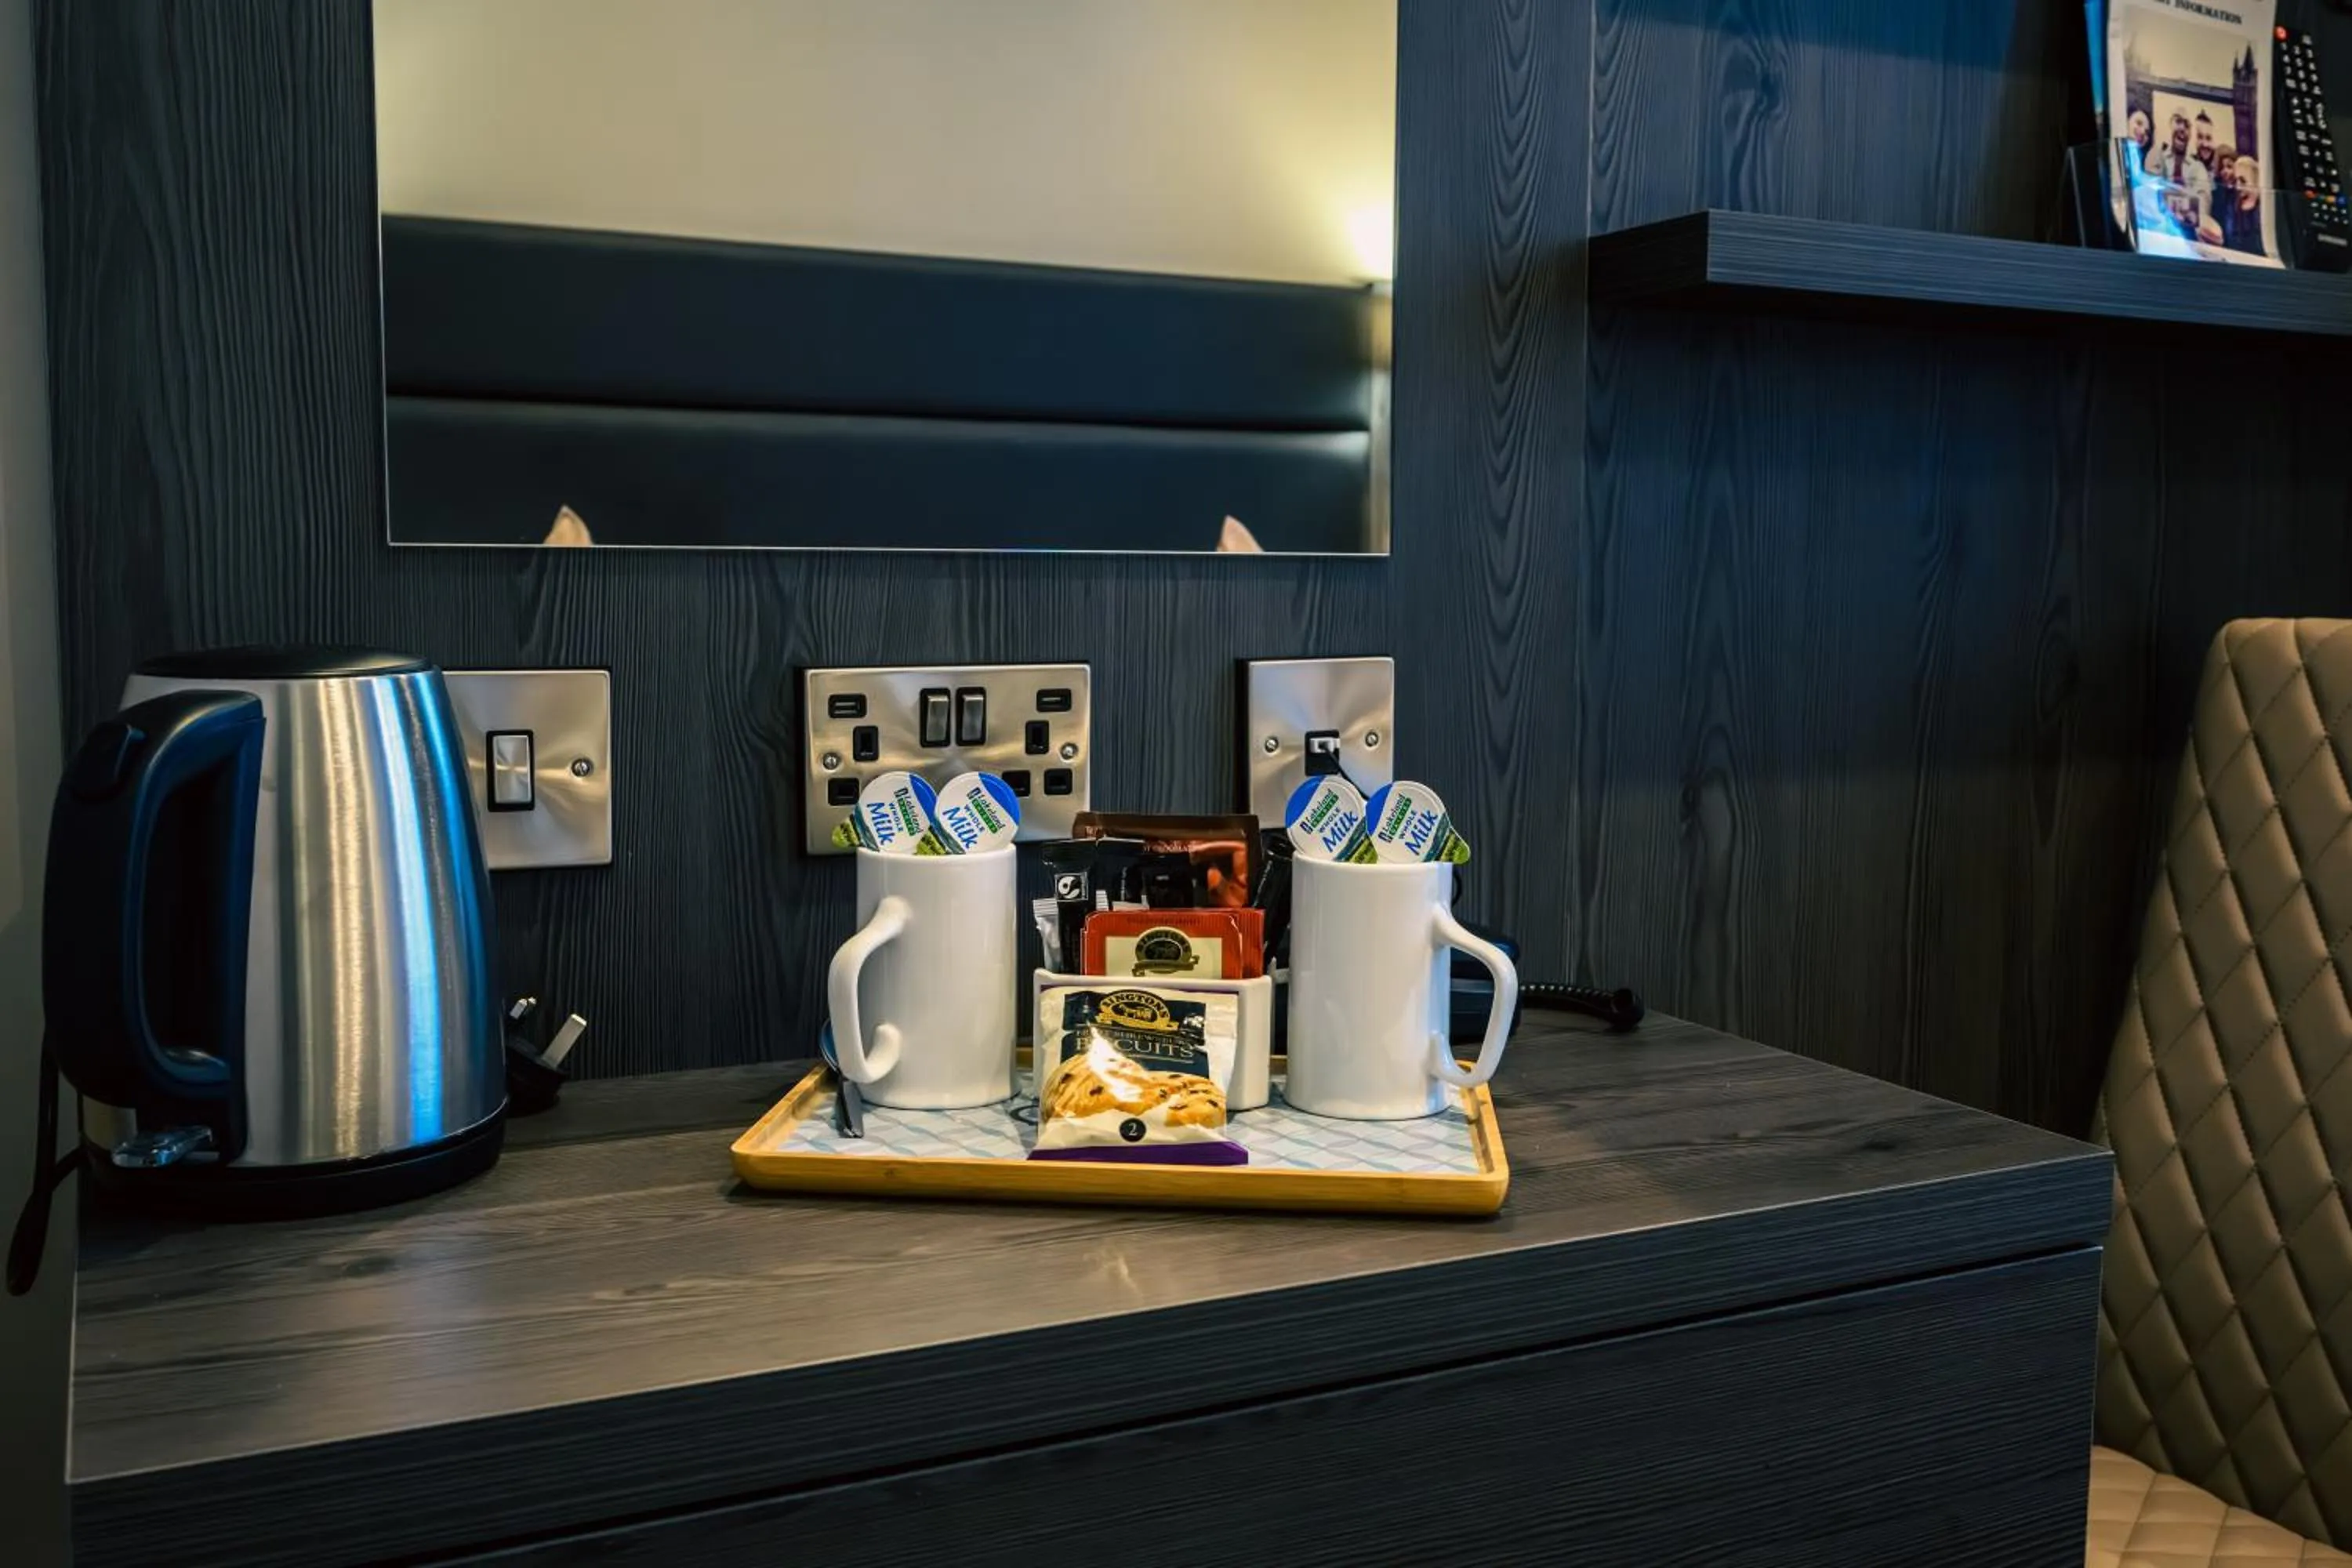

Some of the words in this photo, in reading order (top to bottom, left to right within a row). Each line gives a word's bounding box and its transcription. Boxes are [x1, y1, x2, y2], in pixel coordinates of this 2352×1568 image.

[2175, 0, 2242, 25] INFORMATION
[866, 802, 895, 845] Milk
[888, 802, 903, 832] WHOLE
[942, 807, 978, 848] Milk
[964, 804, 985, 832] WHOLE
[1319, 808, 1341, 833] WHOLE
[1323, 811, 1358, 852] Milk
[1399, 810, 1417, 839] WHOLE
[1405, 810, 1438, 855] Milk
[1076, 1038, 1194, 1058] BCUITS
[1128, 1122, 1138, 1136] 2
